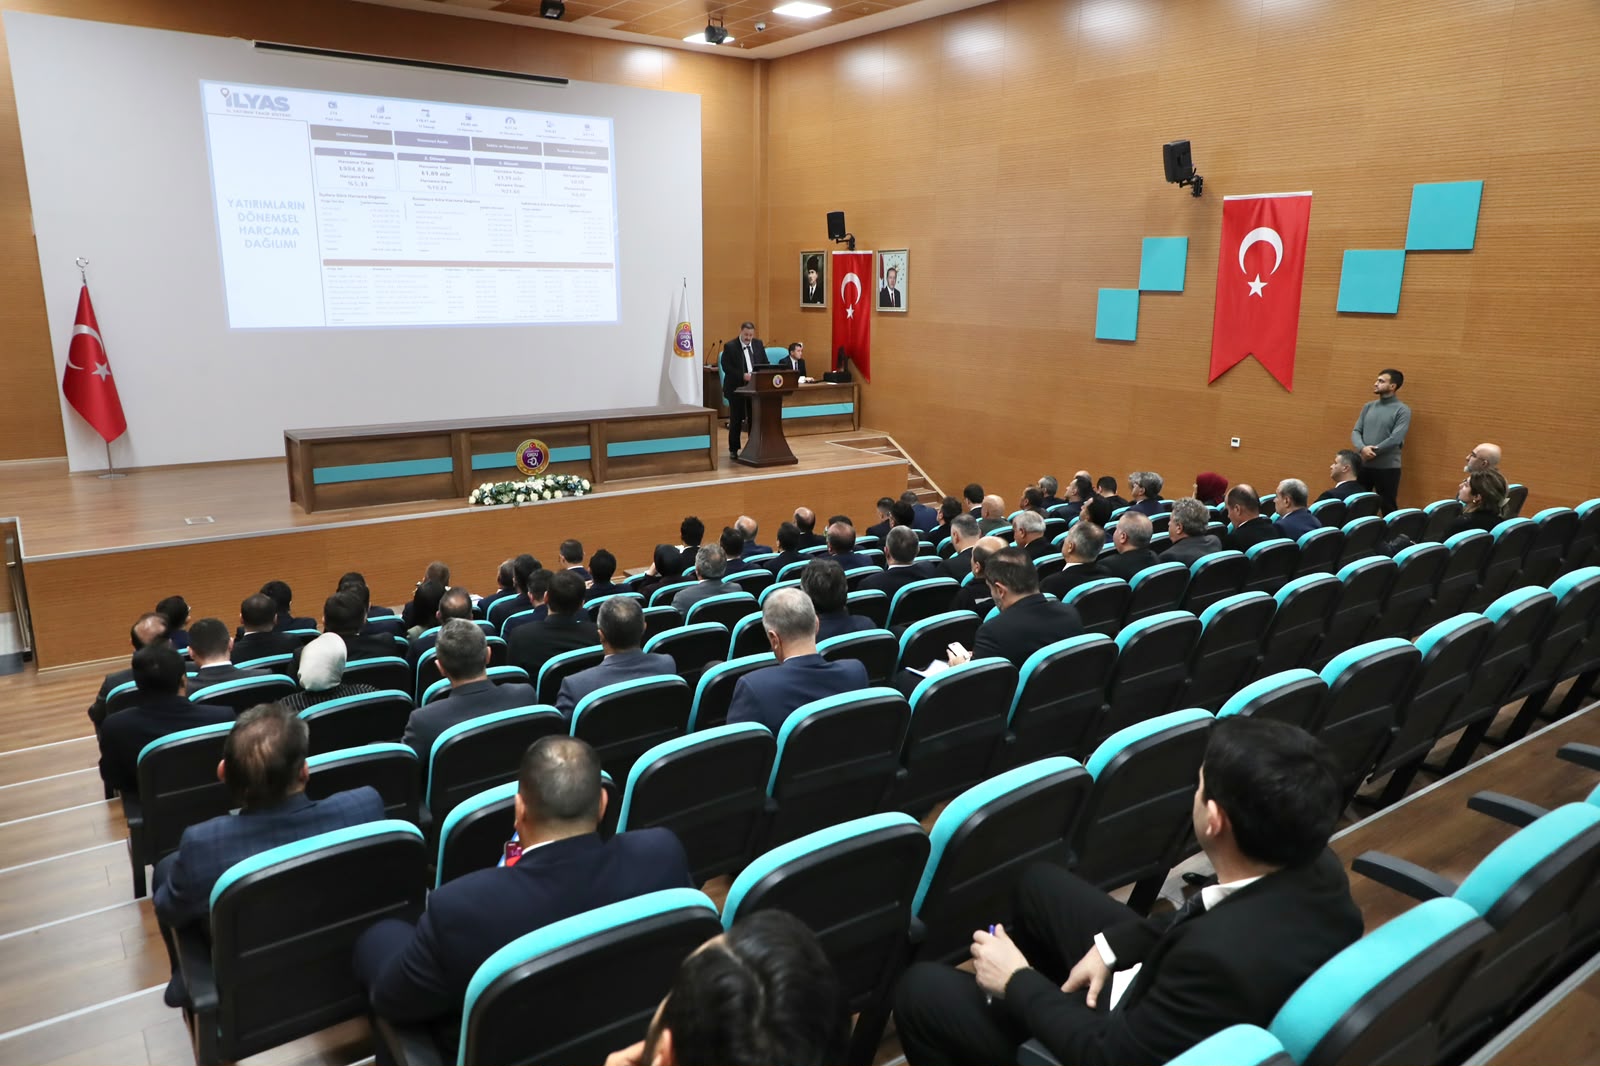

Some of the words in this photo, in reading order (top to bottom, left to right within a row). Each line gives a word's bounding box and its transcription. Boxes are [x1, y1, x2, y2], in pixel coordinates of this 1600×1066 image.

[227, 199, 305, 210] YATIRIMLARIN
[238, 210, 299, 223] DÖNEMSEL
[240, 226, 300, 236] HARCAMA
[244, 237, 296, 248] DAĞILIMI
